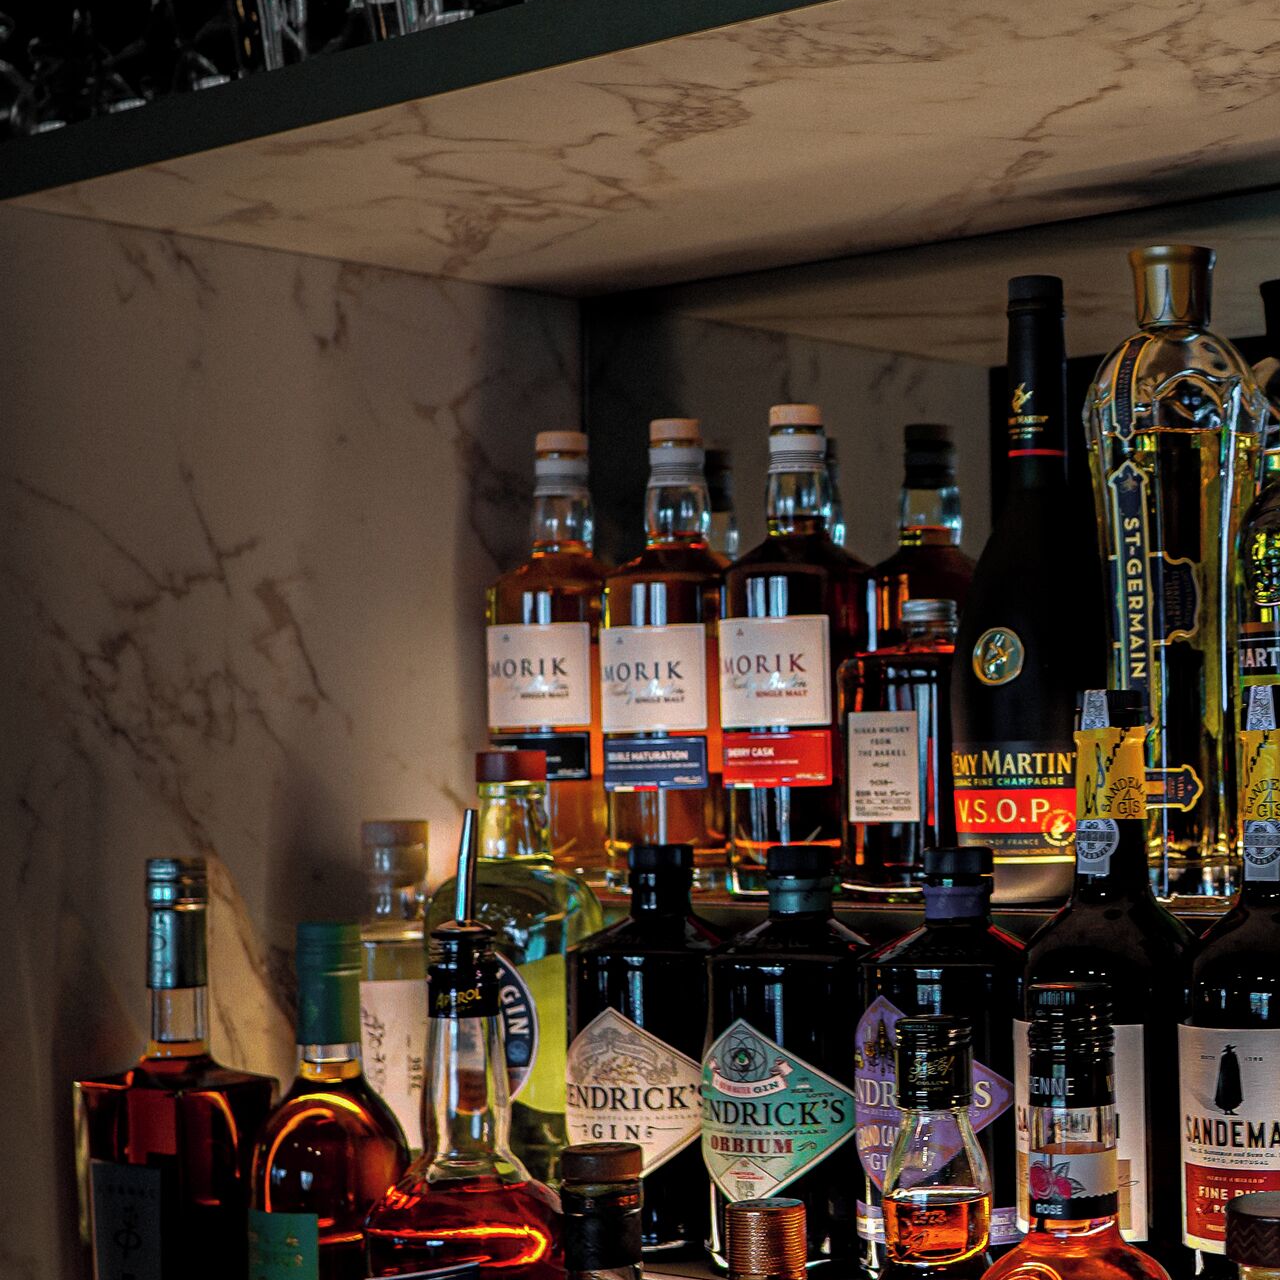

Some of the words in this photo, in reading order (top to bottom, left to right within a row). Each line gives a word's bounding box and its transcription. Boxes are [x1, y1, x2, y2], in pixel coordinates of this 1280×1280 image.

[982, 750, 1071, 775] MARTIN
[996, 777, 1064, 785] CHAMPAGNE
[436, 988, 482, 1009] APROL
[501, 985, 530, 1035] GIN
[753, 1082, 780, 1094] GIN
[592, 1123, 640, 1140] GIN
[711, 1135, 794, 1154] ORBIUM
[1198, 1185, 1228, 1199] FINE
